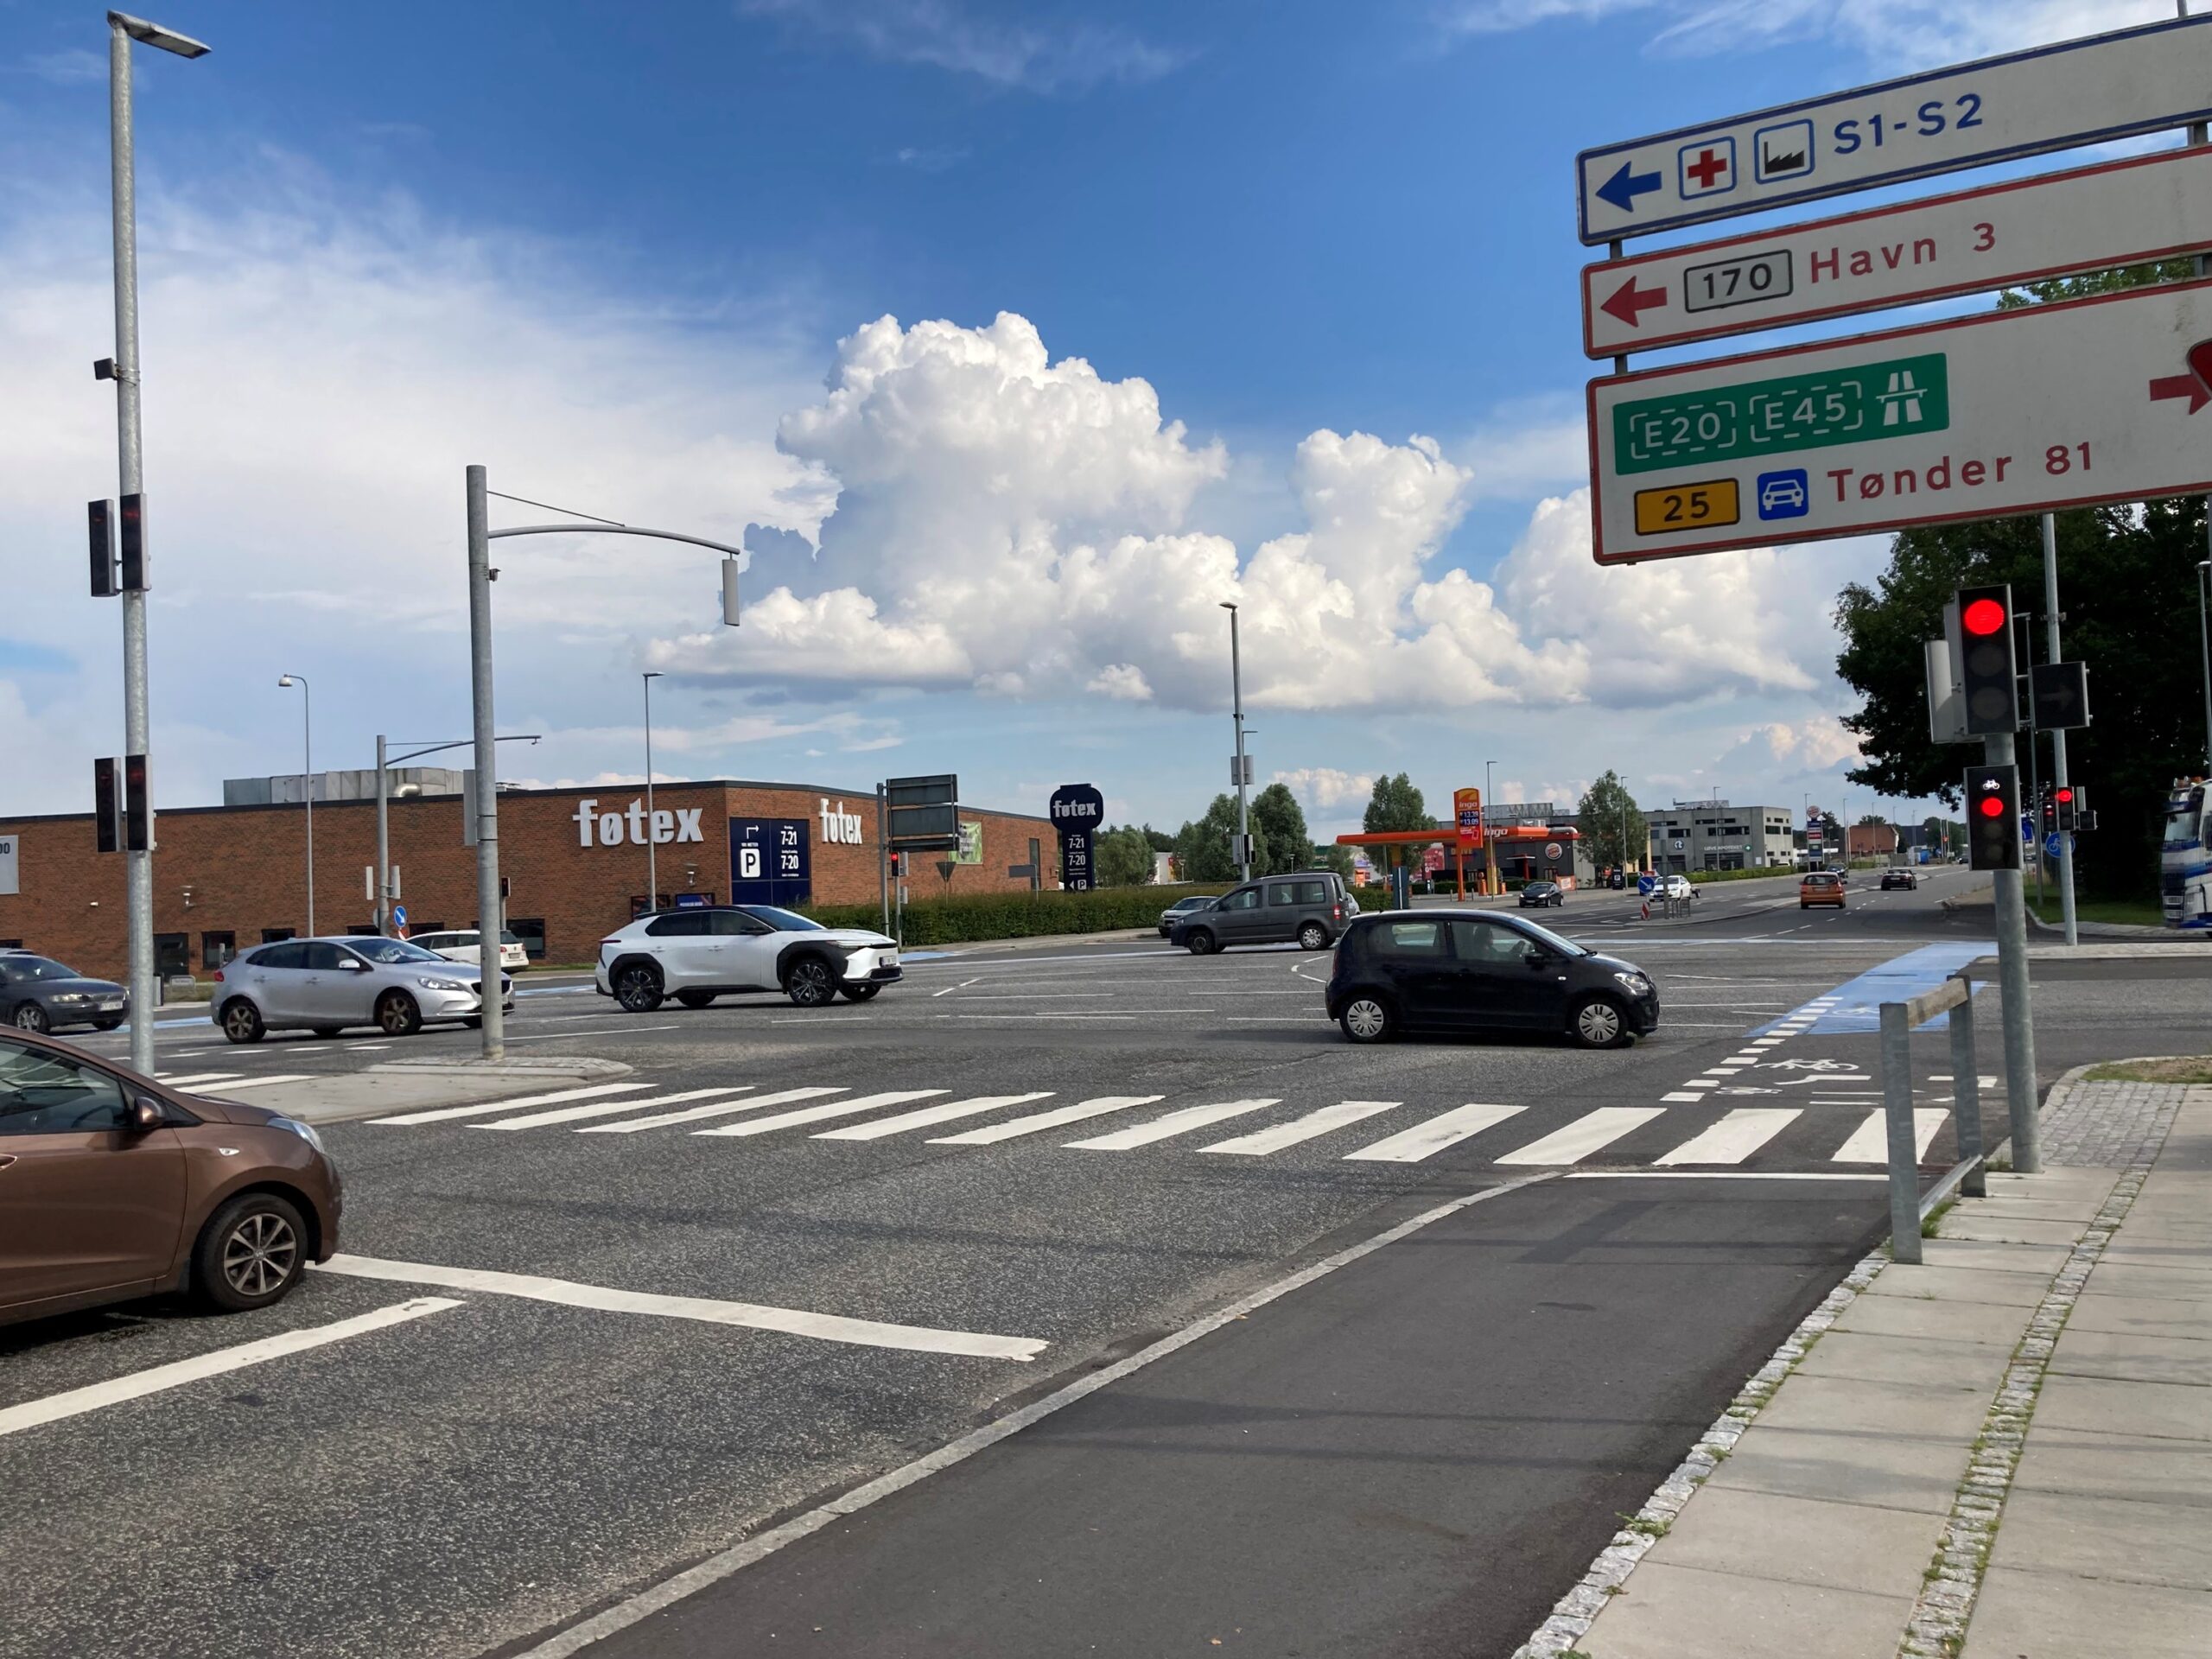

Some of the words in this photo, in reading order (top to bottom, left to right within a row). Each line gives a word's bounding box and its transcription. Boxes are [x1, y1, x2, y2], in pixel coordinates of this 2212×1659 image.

[1834, 93, 1983, 155] S1-S2
[1702, 264, 1770, 300] 170
[1811, 236, 1937, 283] Havn
[1973, 223, 1996, 251] 3
[1644, 412, 1722, 448] E20
[1765, 392, 1847, 430] E45
[1662, 491, 1710, 522] 25
[1827, 455, 2012, 502] Tønder
[2045, 442, 2092, 475] 81
[1053, 799, 1096, 818] føtex
[572, 798, 704, 847] føtex
[819, 798, 862, 844] føtex
[780, 830, 798, 846] 7-21
[1068, 837, 1084, 849] 7-21
[1484, 828, 1508, 837] ingo
[746, 853, 756, 874] P
[780, 855, 799, 870] 7-20
[1068, 855, 1086, 867] 7-20
